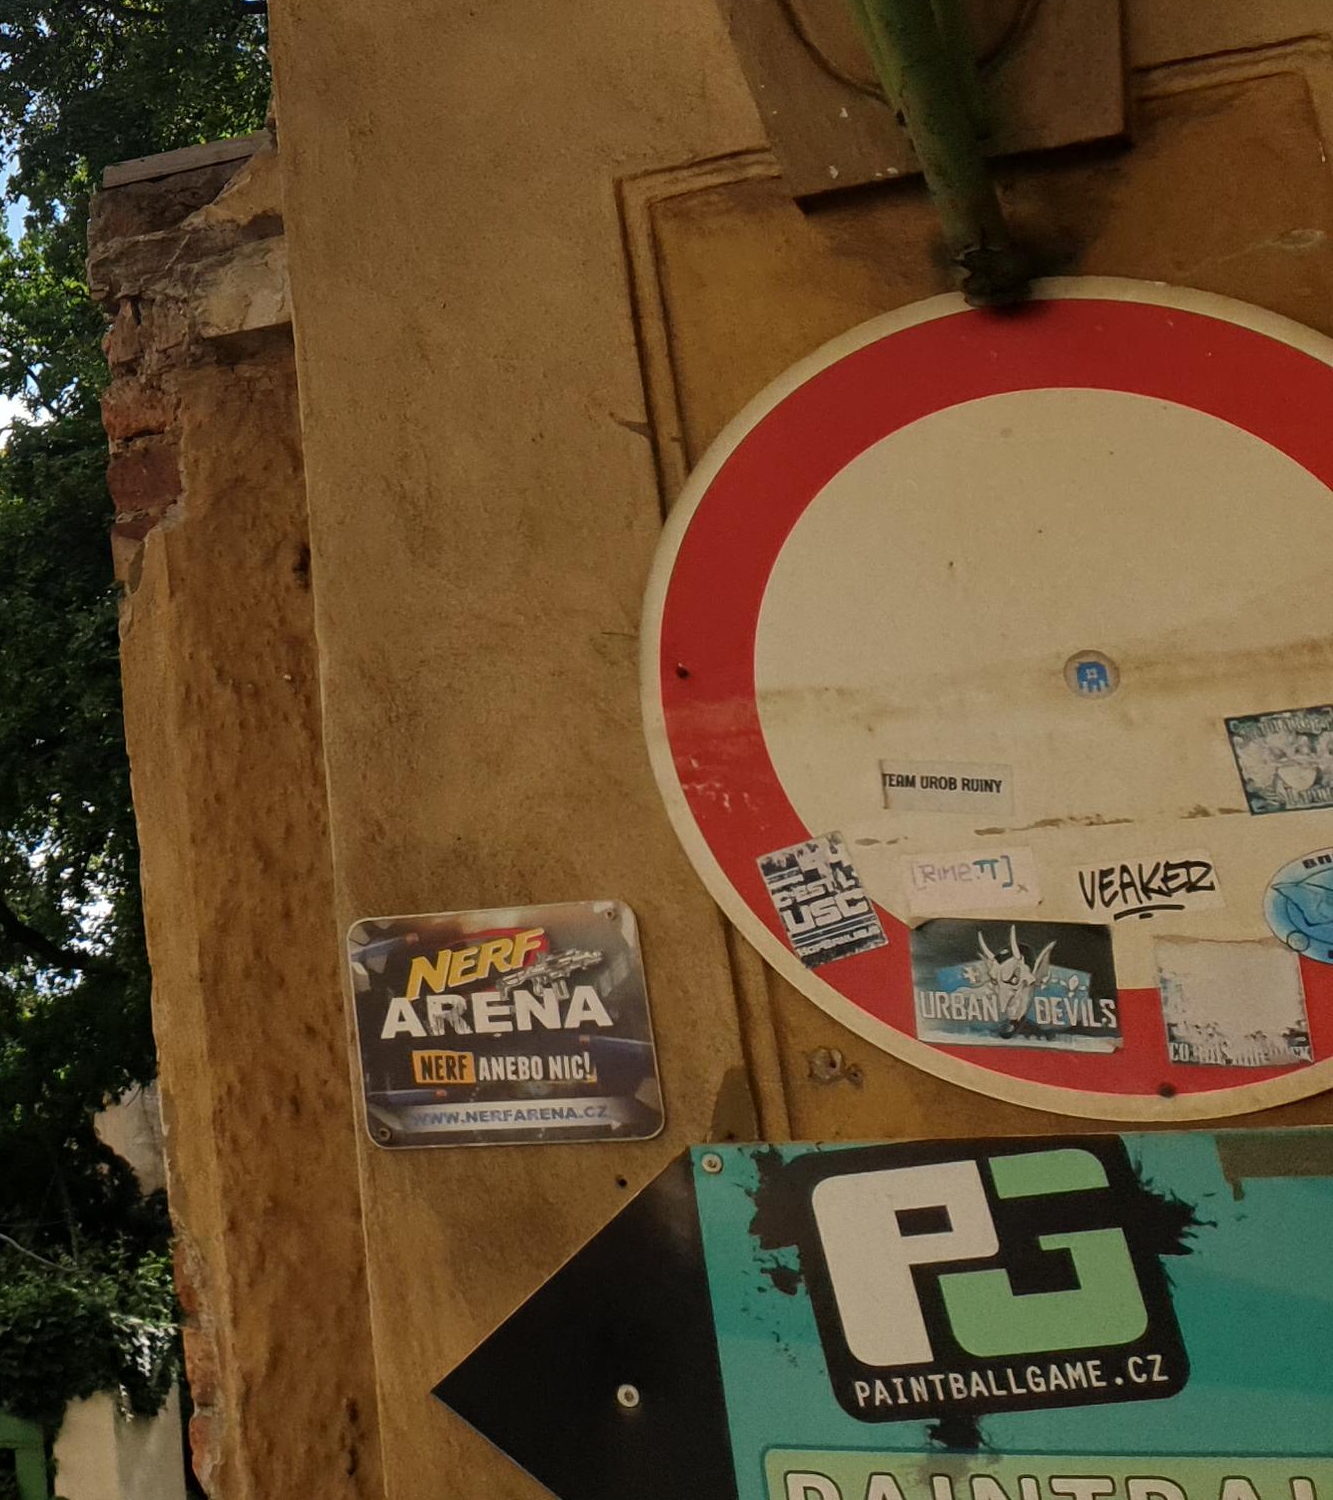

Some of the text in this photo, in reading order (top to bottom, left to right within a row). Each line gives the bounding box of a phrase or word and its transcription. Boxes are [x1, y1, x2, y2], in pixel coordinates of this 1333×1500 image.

[881, 772, 1003, 794] TEAM UROB RUINY
[405, 927, 546, 1001] NERF
[381, 984, 614, 1040] ARENA
[918, 990, 1118, 1029] URBAN DEVILS
[420, 1051, 593, 1082] NERF ANEBO NIC!
[413, 1104, 609, 1127] WWW.NERFARENA.CZ
[811, 1148, 1149, 1367] PG
[853, 1354, 1170, 1409] PAINTBALLGAME.CZ
